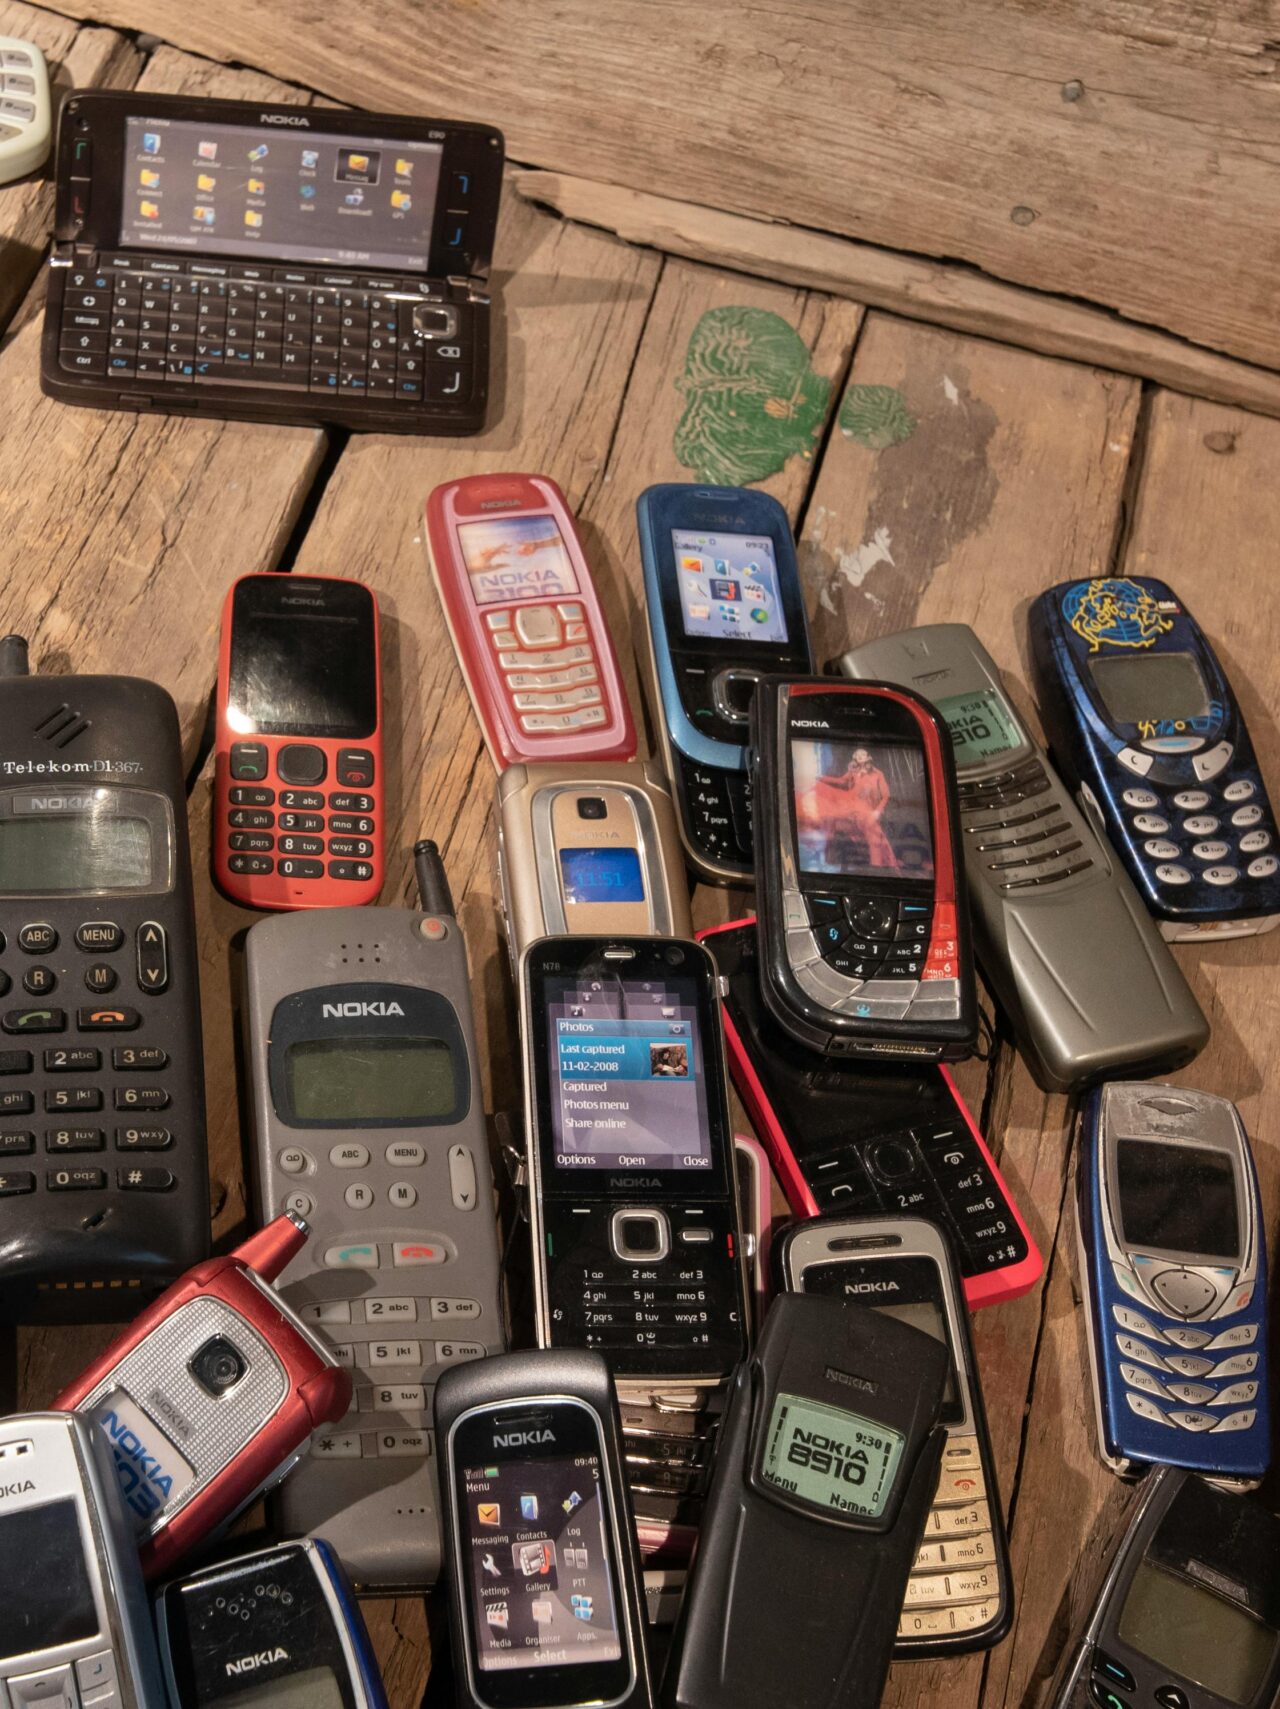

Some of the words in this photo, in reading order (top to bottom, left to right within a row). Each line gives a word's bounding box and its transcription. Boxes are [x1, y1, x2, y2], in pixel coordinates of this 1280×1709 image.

[260, 114, 311, 127] NOKIA
[428, 131, 446, 139] E90
[191, 265, 226, 276] Messaging
[481, 500, 523, 509] NOKIA
[480, 569, 560, 590] NOKIA
[281, 597, 326, 607] NOKIA
[722, 628, 752, 640] Select
[791, 719, 829, 729] NOKIA
[949, 723, 992, 747] 310
[31, 798, 97, 810] NOKIA
[286, 793, 295, 805] 2
[303, 797, 318, 806] abc
[335, 797, 350, 807] def
[359, 798, 368, 809] 3
[332, 821, 352, 829] mno
[358, 820, 367, 831] 6
[302, 842, 317, 851] tuv
[331, 843, 353, 853] wxyz
[358, 842, 367, 854] 9
[26, 930, 50, 942] ABC
[82, 929, 115, 941] MENU
[542, 962, 561, 971] N78
[33, 971, 44, 985] R
[95, 970, 107, 983] M
[322, 1002, 405, 1018] NOKIA
[559, 1022, 594, 1033] Photos
[561, 1044, 580, 1054] Last
[581, 1044, 625, 1055] captured
[54, 1052, 67, 1065] 2
[71, 1051, 94, 1060] abc
[123, 1050, 136, 1063] 3
[140, 1049, 160, 1059] def
[562, 1061, 619, 1072] 11-02-2008
[563, 1082, 608, 1093] Captured
[4, 1093, 23, 1105] ghi
[55, 1092, 68, 1105] 5
[77, 1090, 91, 1101] jkl
[125, 1089, 137, 1102] 6
[141, 1089, 160, 1098] mn
[564, 1099, 598, 1110] Photos
[599, 1101, 630, 1110] menu
[565, 1119, 593, 1129] Share
[594, 1119, 627, 1129] online
[4, 1134, 25, 1145] prs
[56, 1131, 69, 1144] 8
[75, 1130, 94, 1140] tuv
[126, 1130, 138, 1143] 9
[140, 1130, 164, 1140] wxy
[341, 1150, 359, 1159] ABC
[394, 1149, 418, 1157] MENU
[557, 1154, 597, 1166] Options
[618, 1155, 646, 1167] Open
[683, 1155, 709, 1166] Close
[56, 1171, 70, 1185] 0
[73, 1171, 96, 1181] oqz
[610, 1177, 662, 1188] NOKIA
[957, 1178, 972, 1189] def
[975, 1227, 998, 1239] wxyz
[844, 1278, 900, 1295] NOKIA
[825, 1368, 874, 1393] NOKIA
[150, 1391, 190, 1438] NOKIA
[493, 1429, 556, 1448] NOKIA
[855, 1432, 883, 1450] 9:30
[792, 1427, 869, 1465] NOKIA
[100, 1410, 173, 1498] NOKIA
[574, 1456, 598, 1466] 09:40
[787, 1441, 867, 1486] 8910
[764, 1470, 798, 1492] Menu
[466, 1482, 490, 1493] Menu
[471, 1534, 509, 1546] Messaging
[516, 1530, 548, 1541] Contacts
[567, 1527, 581, 1537] Log
[480, 1585, 510, 1597] Settings
[525, 1581, 551, 1593] Gallery
[573, 1578, 587, 1588] PTT
[489, 1639, 512, 1649] Media
[525, 1634, 561, 1646] Organiser
[577, 1630, 597, 1642] Apps.
[226, 1646, 289, 1677] NOKIA
[483, 1655, 518, 1668] Options
[533, 1650, 567, 1663] Select
